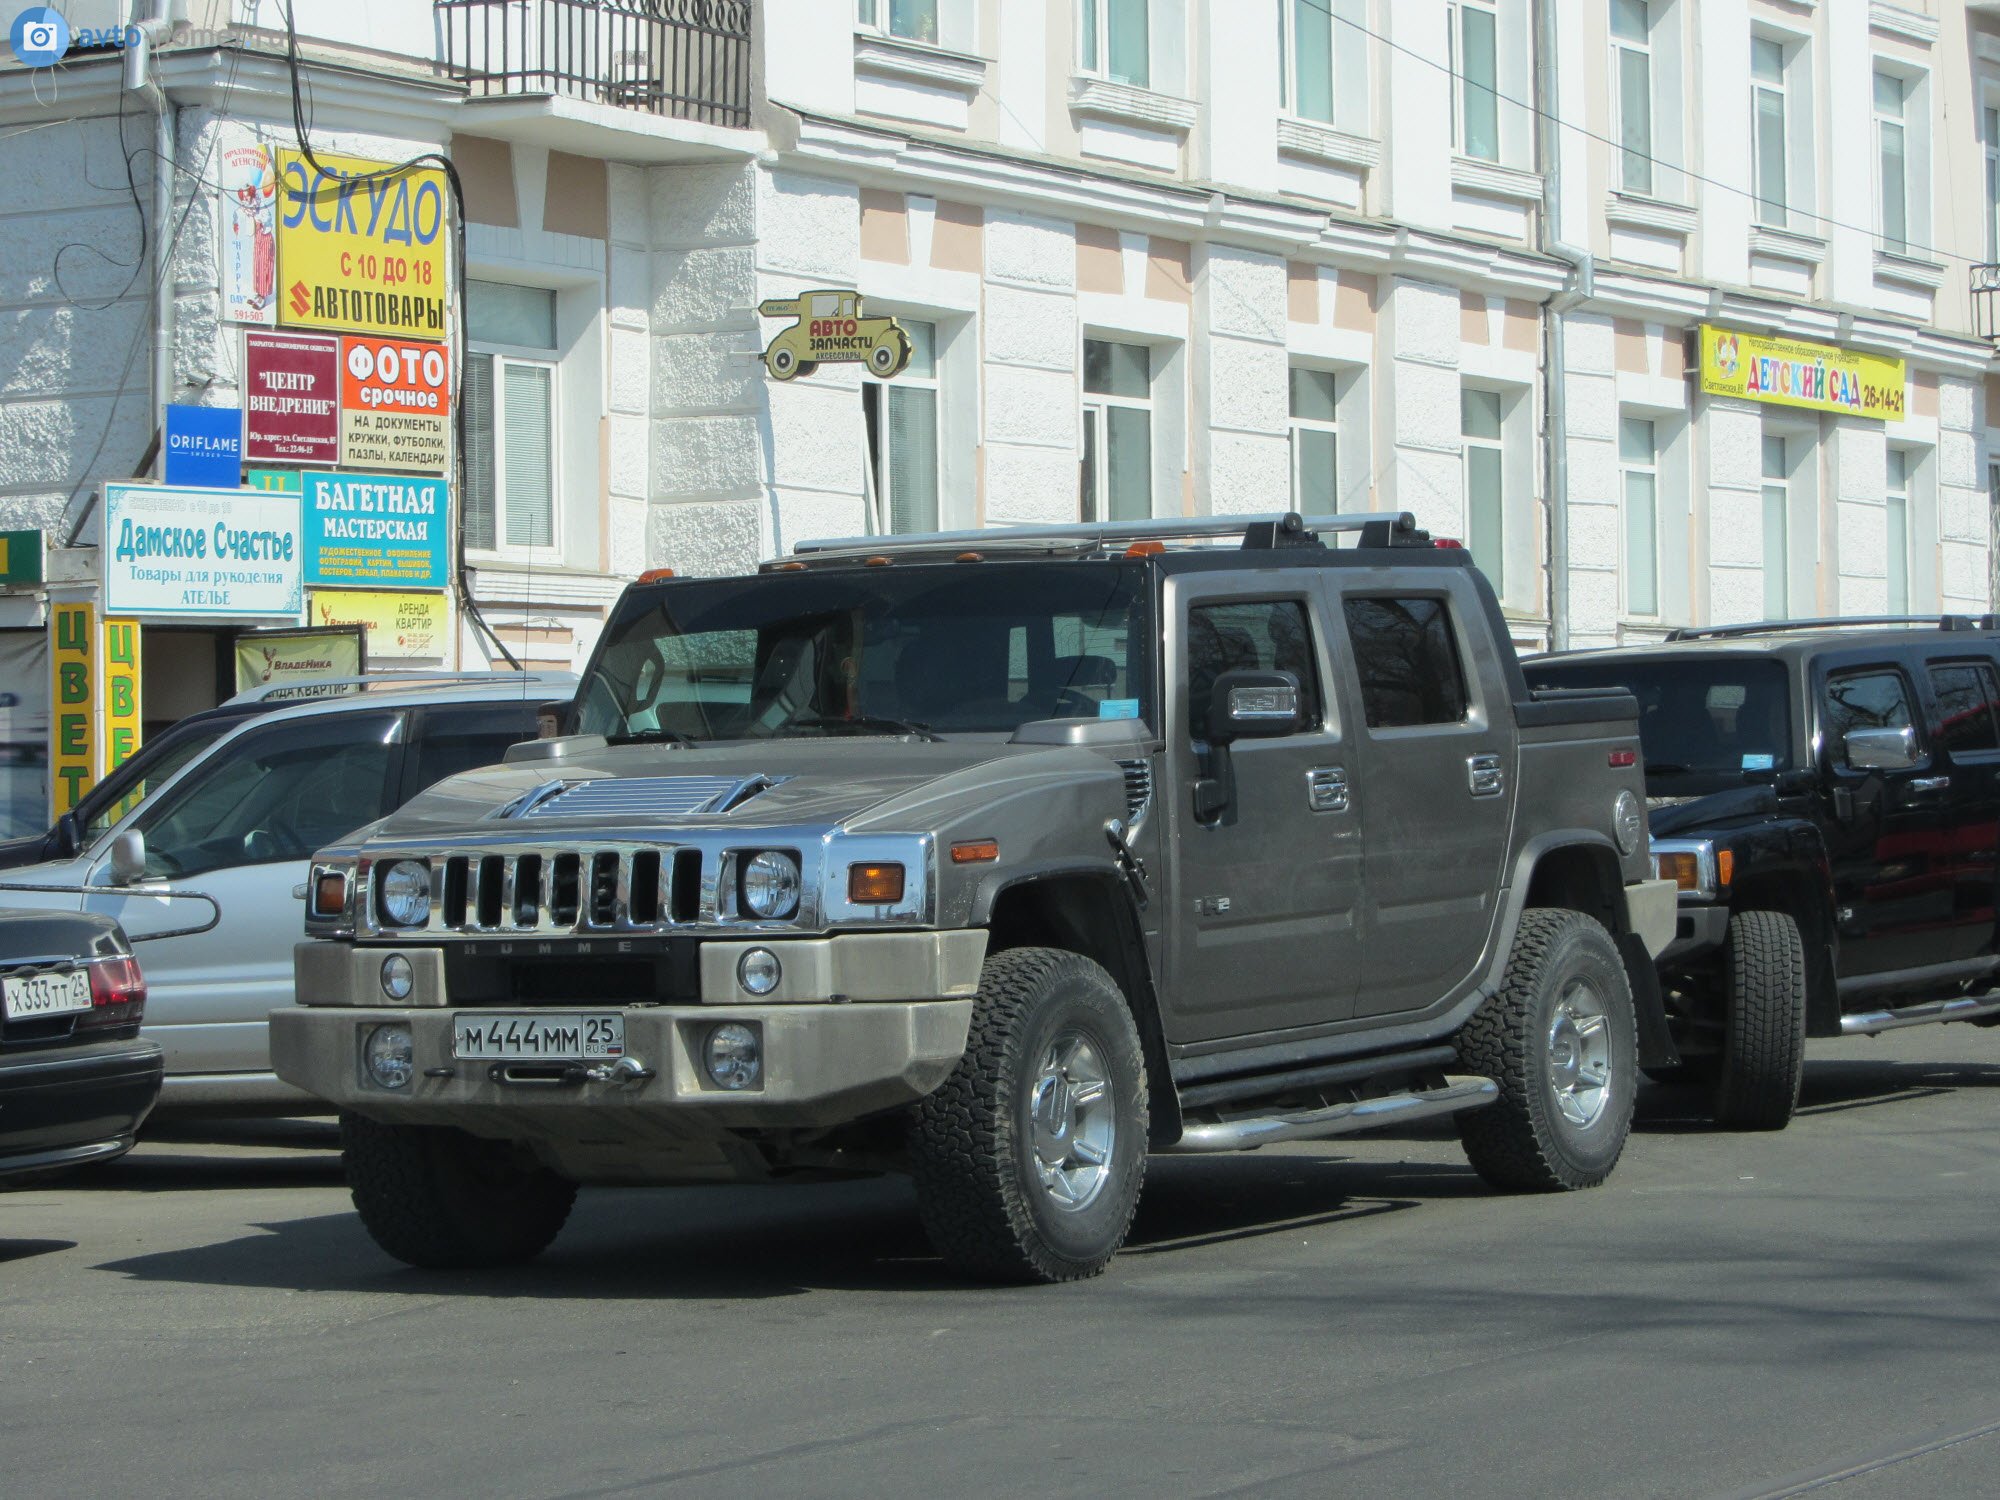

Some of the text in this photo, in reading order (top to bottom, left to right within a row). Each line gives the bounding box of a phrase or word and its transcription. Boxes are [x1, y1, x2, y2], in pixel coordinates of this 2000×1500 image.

[283, 161, 442, 247] ЭСКУДО
[340, 252, 432, 286] С 10 ДО 18
[314, 285, 443, 330] АВТОТОВАРЫ
[810, 320, 857, 336] АВТО
[810, 337, 872, 350] ЗАПЧАСТИ
[348, 344, 445, 388] ФОТО
[816, 352, 860, 360] АКСЕССУАРЫ
[1747, 356, 1861, 410] ДЕТСКИЙ САД
[360, 386, 439, 408] срочное
[1863, 385, 1905, 412] 26-14-21
[354, 415, 441, 432] НА ДОКУМЕНТЫ
[170, 434, 239, 452] ORIFLAME
[348, 432, 445, 450] КРУЖКИ, ФУТБОЛКИ,
[348, 448, 445, 465] ПАЗЛЫ, КАЛЕНДАРИ
[315, 481, 436, 514] БАГЕТНАЯ
[324, 517, 428, 540] МАСТЕРСКАЯ
[116, 518, 293, 562] Дамское Счастье
[130, 565, 283, 586] Товары для рукоделия
[181, 590, 230, 605] АТЕЛЬЕ
[398, 603, 430, 617] АРЕНДА
[395, 618, 433, 630] КВАРТИР
[58, 611, 89, 808] ЦВЕТ
[71, 975, 85, 998] 25
[466, 1018, 614, 1052] М444ММ 25
[585, 1045, 606, 1054] RUS
